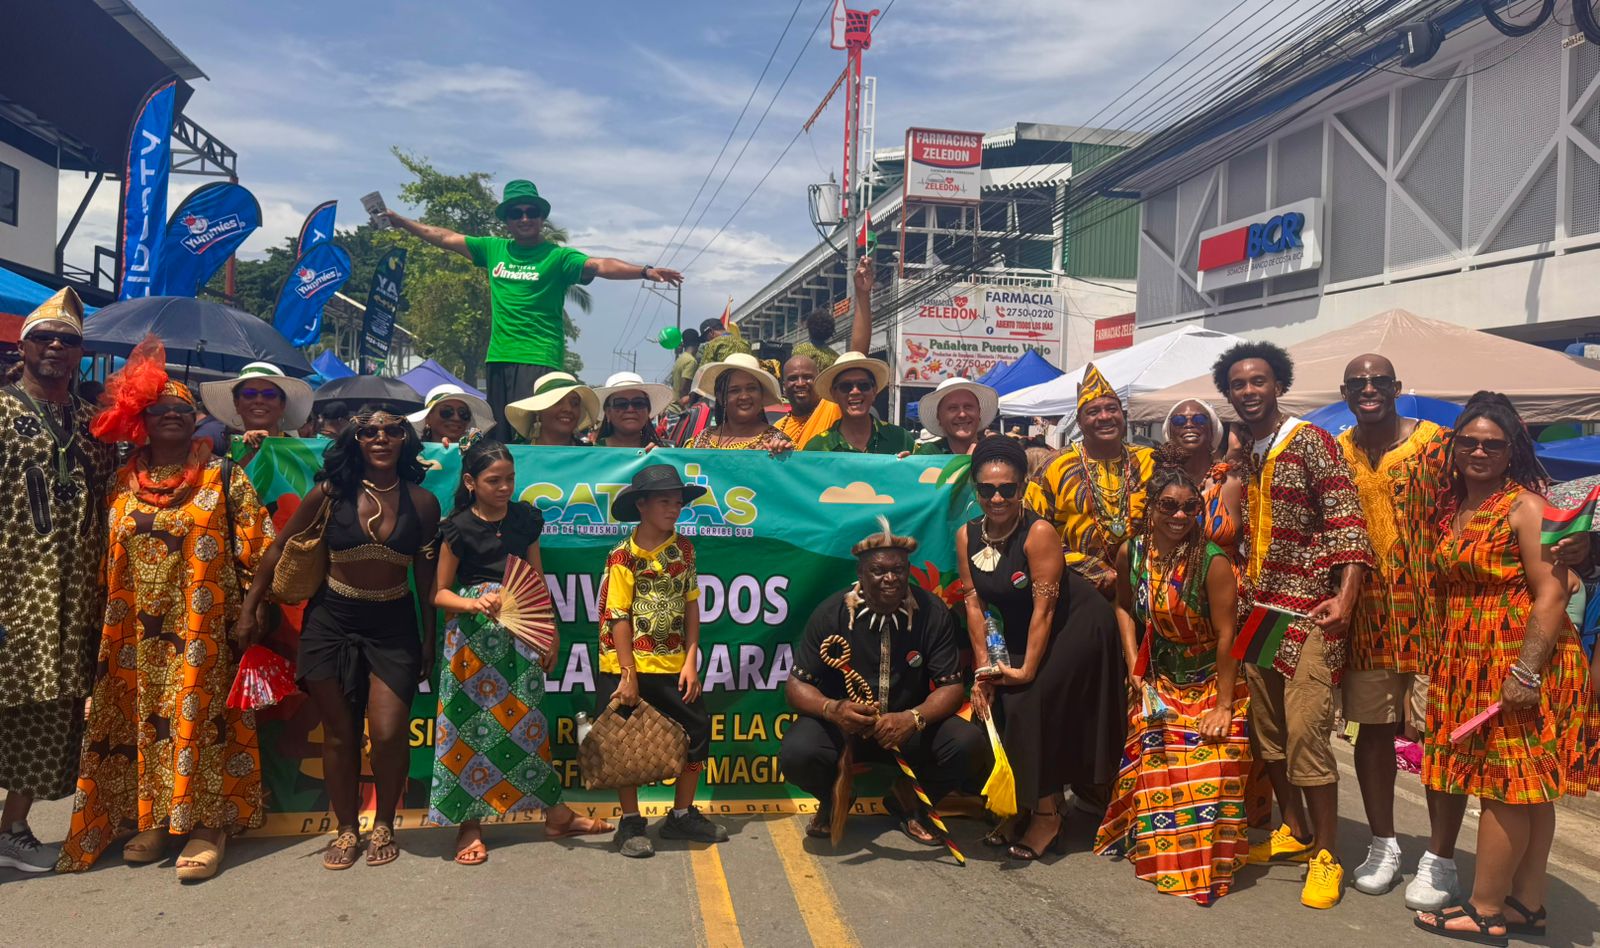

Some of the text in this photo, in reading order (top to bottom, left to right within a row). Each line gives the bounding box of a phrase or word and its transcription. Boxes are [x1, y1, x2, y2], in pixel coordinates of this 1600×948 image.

[916, 132, 977, 148] FARMACIAS
[922, 147, 970, 162] ZELEDON
[925, 182, 960, 192] ZELEDON
[185, 219, 238, 249] Yummies
[1247, 211, 1305, 260] BCR
[492, 261, 540, 280] Jiménez
[298, 270, 336, 294] Yummies
[985, 291, 1053, 305] FARMACIA
[919, 305, 977, 320] ZELEDON
[1006, 307, 1054, 318] 2750-0220
[929, 339, 978, 352] Pañalera
[982, 341, 1019, 353] Puerto
[562, 525, 574, 535] DE
[577, 525, 618, 536] TURISMO
[621, 526, 628, 535] Y
[680, 526, 754, 537] DEL CARIBE SUR
[734, 714, 767, 740] LA
[706, 756, 785, 784] MAGI
[746, 803, 784, 813] DEL
